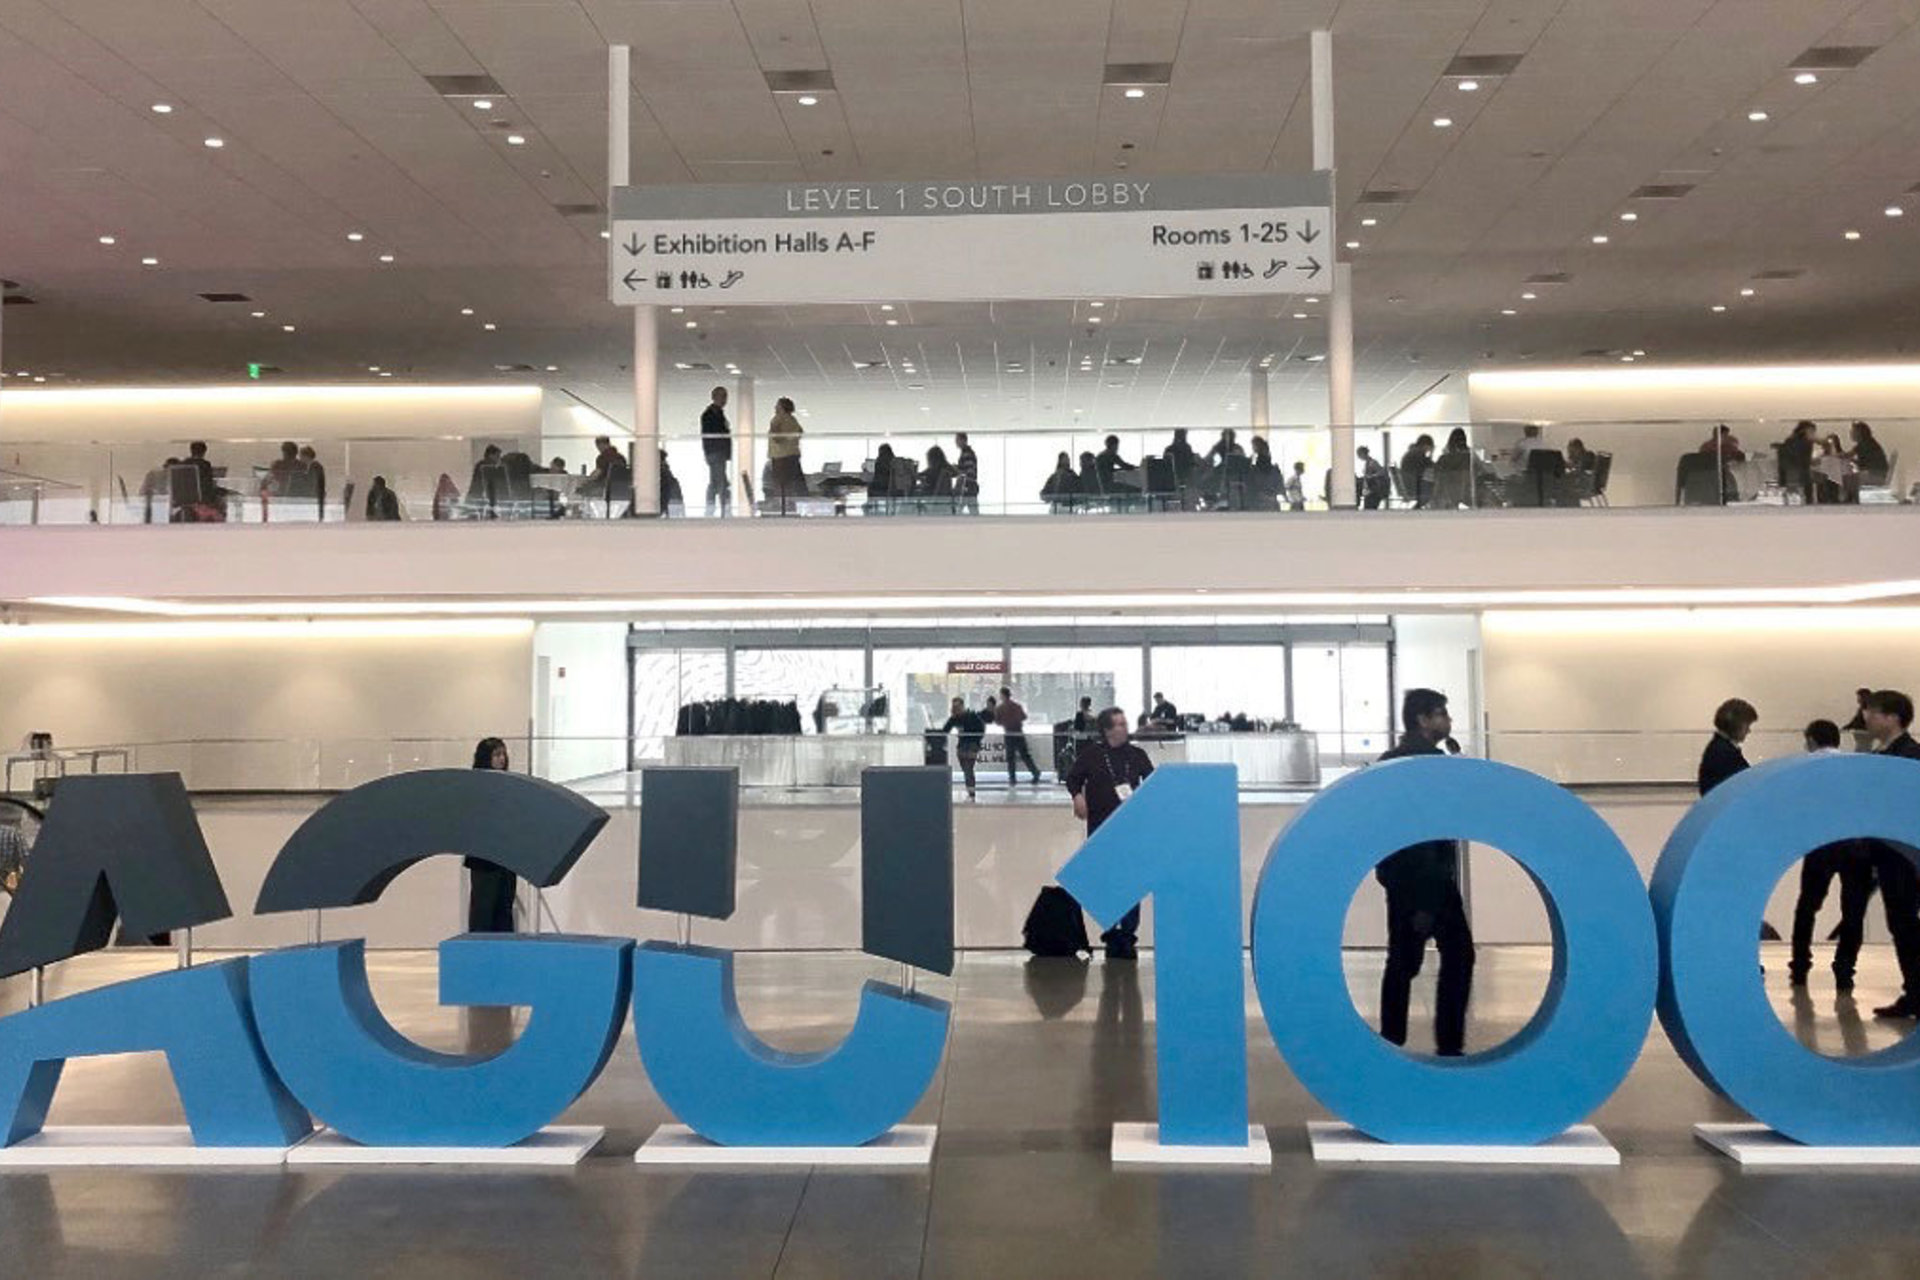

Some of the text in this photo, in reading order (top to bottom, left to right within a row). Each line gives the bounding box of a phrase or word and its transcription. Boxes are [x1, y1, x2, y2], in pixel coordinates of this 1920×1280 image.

[786, 183, 1151, 211] LEVEL 1 SOUTH LOBBY
[653, 231, 876, 255] Exhibition Halls A-F
[1153, 222, 1288, 245] Rooms 1-25
[0, 768, 955, 1148] AGU
